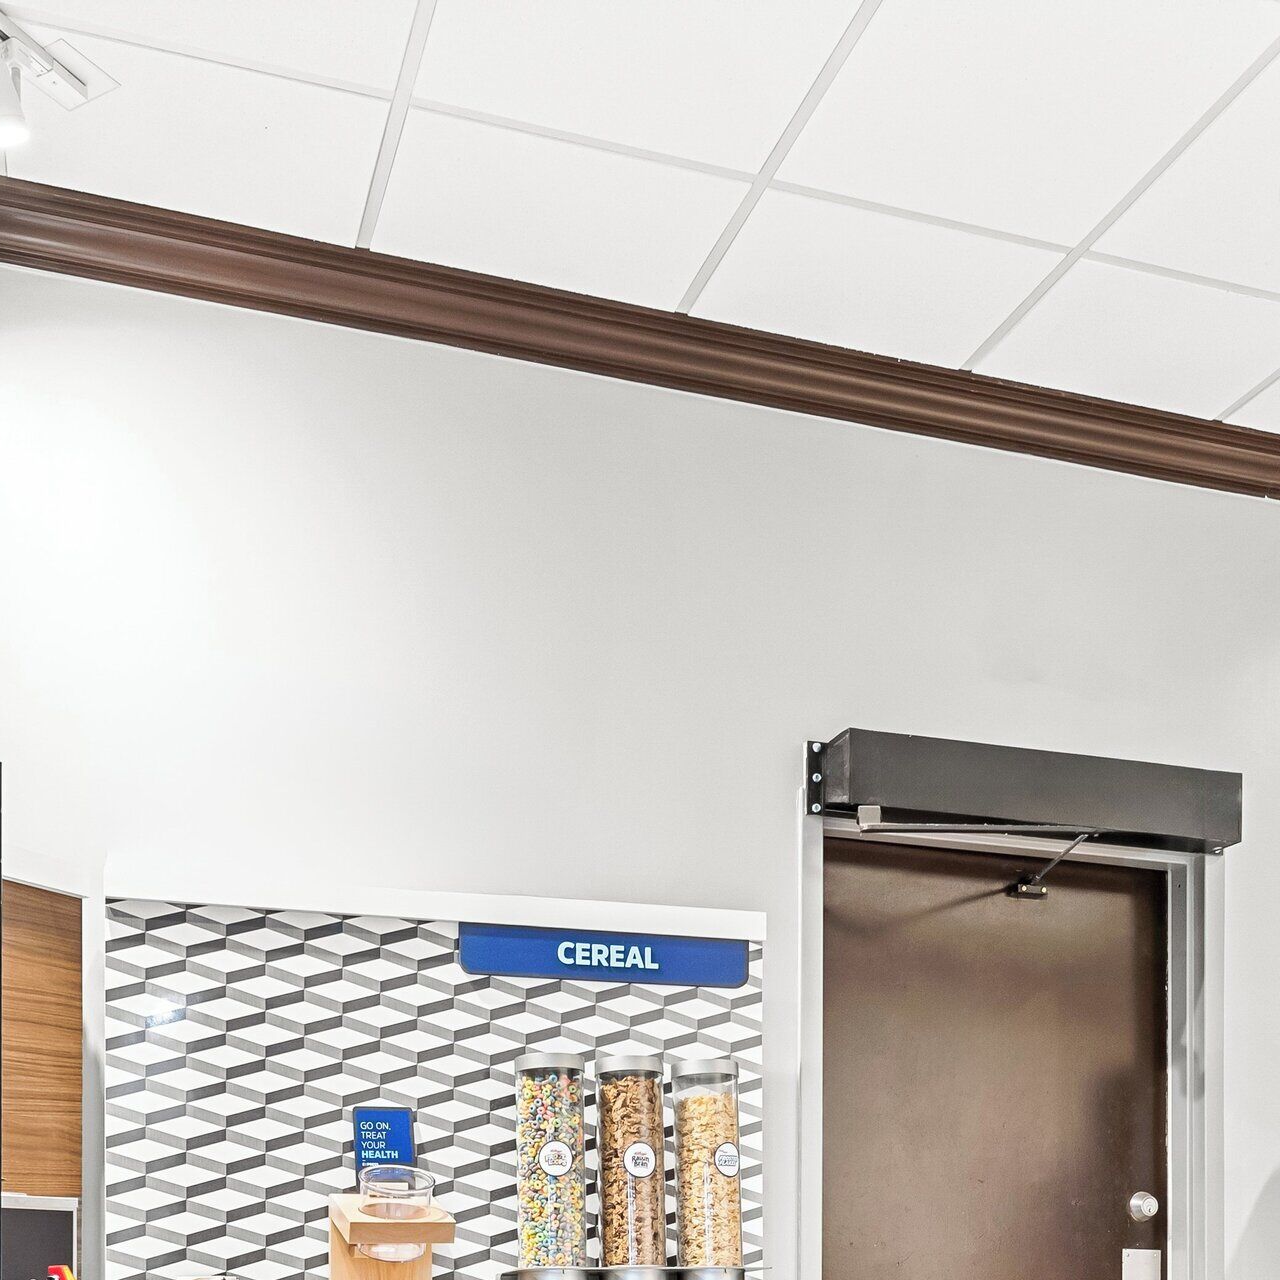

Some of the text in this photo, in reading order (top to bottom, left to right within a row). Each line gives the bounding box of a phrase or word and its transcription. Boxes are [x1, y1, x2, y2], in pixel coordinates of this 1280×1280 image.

[557, 941, 660, 970] CEREAL
[360, 1121, 374, 1130] GO
[361, 1131, 387, 1139] TREAT
[361, 1141, 386, 1149] YOUR
[361, 1150, 399, 1159] HEALTH
